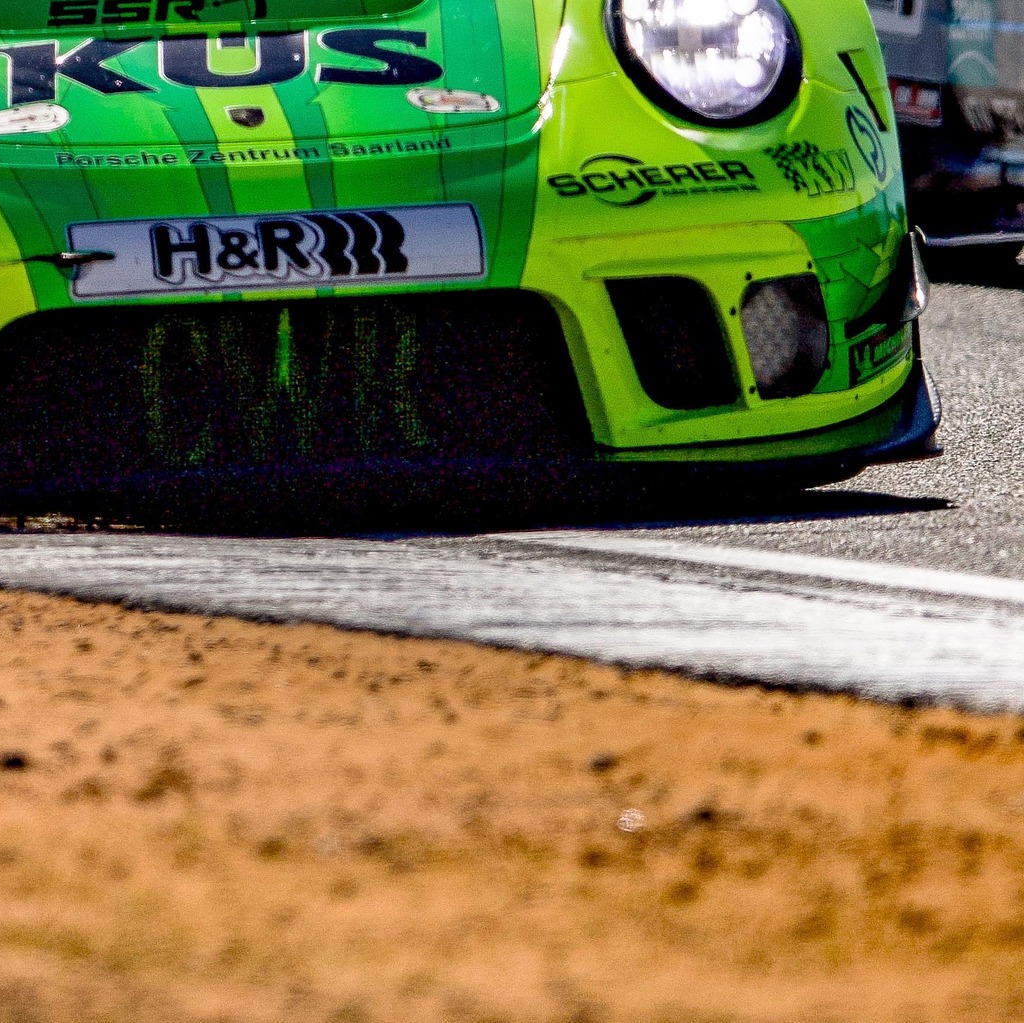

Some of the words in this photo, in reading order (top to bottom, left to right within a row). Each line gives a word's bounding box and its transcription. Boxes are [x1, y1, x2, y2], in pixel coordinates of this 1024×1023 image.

[55, 152, 177, 169] Porsche
[188, 146, 321, 165] Zentrum
[329, 134, 453, 159] Saarland
[545, 159, 757, 198] SCHERER
[151, 218, 320, 283] H&R
